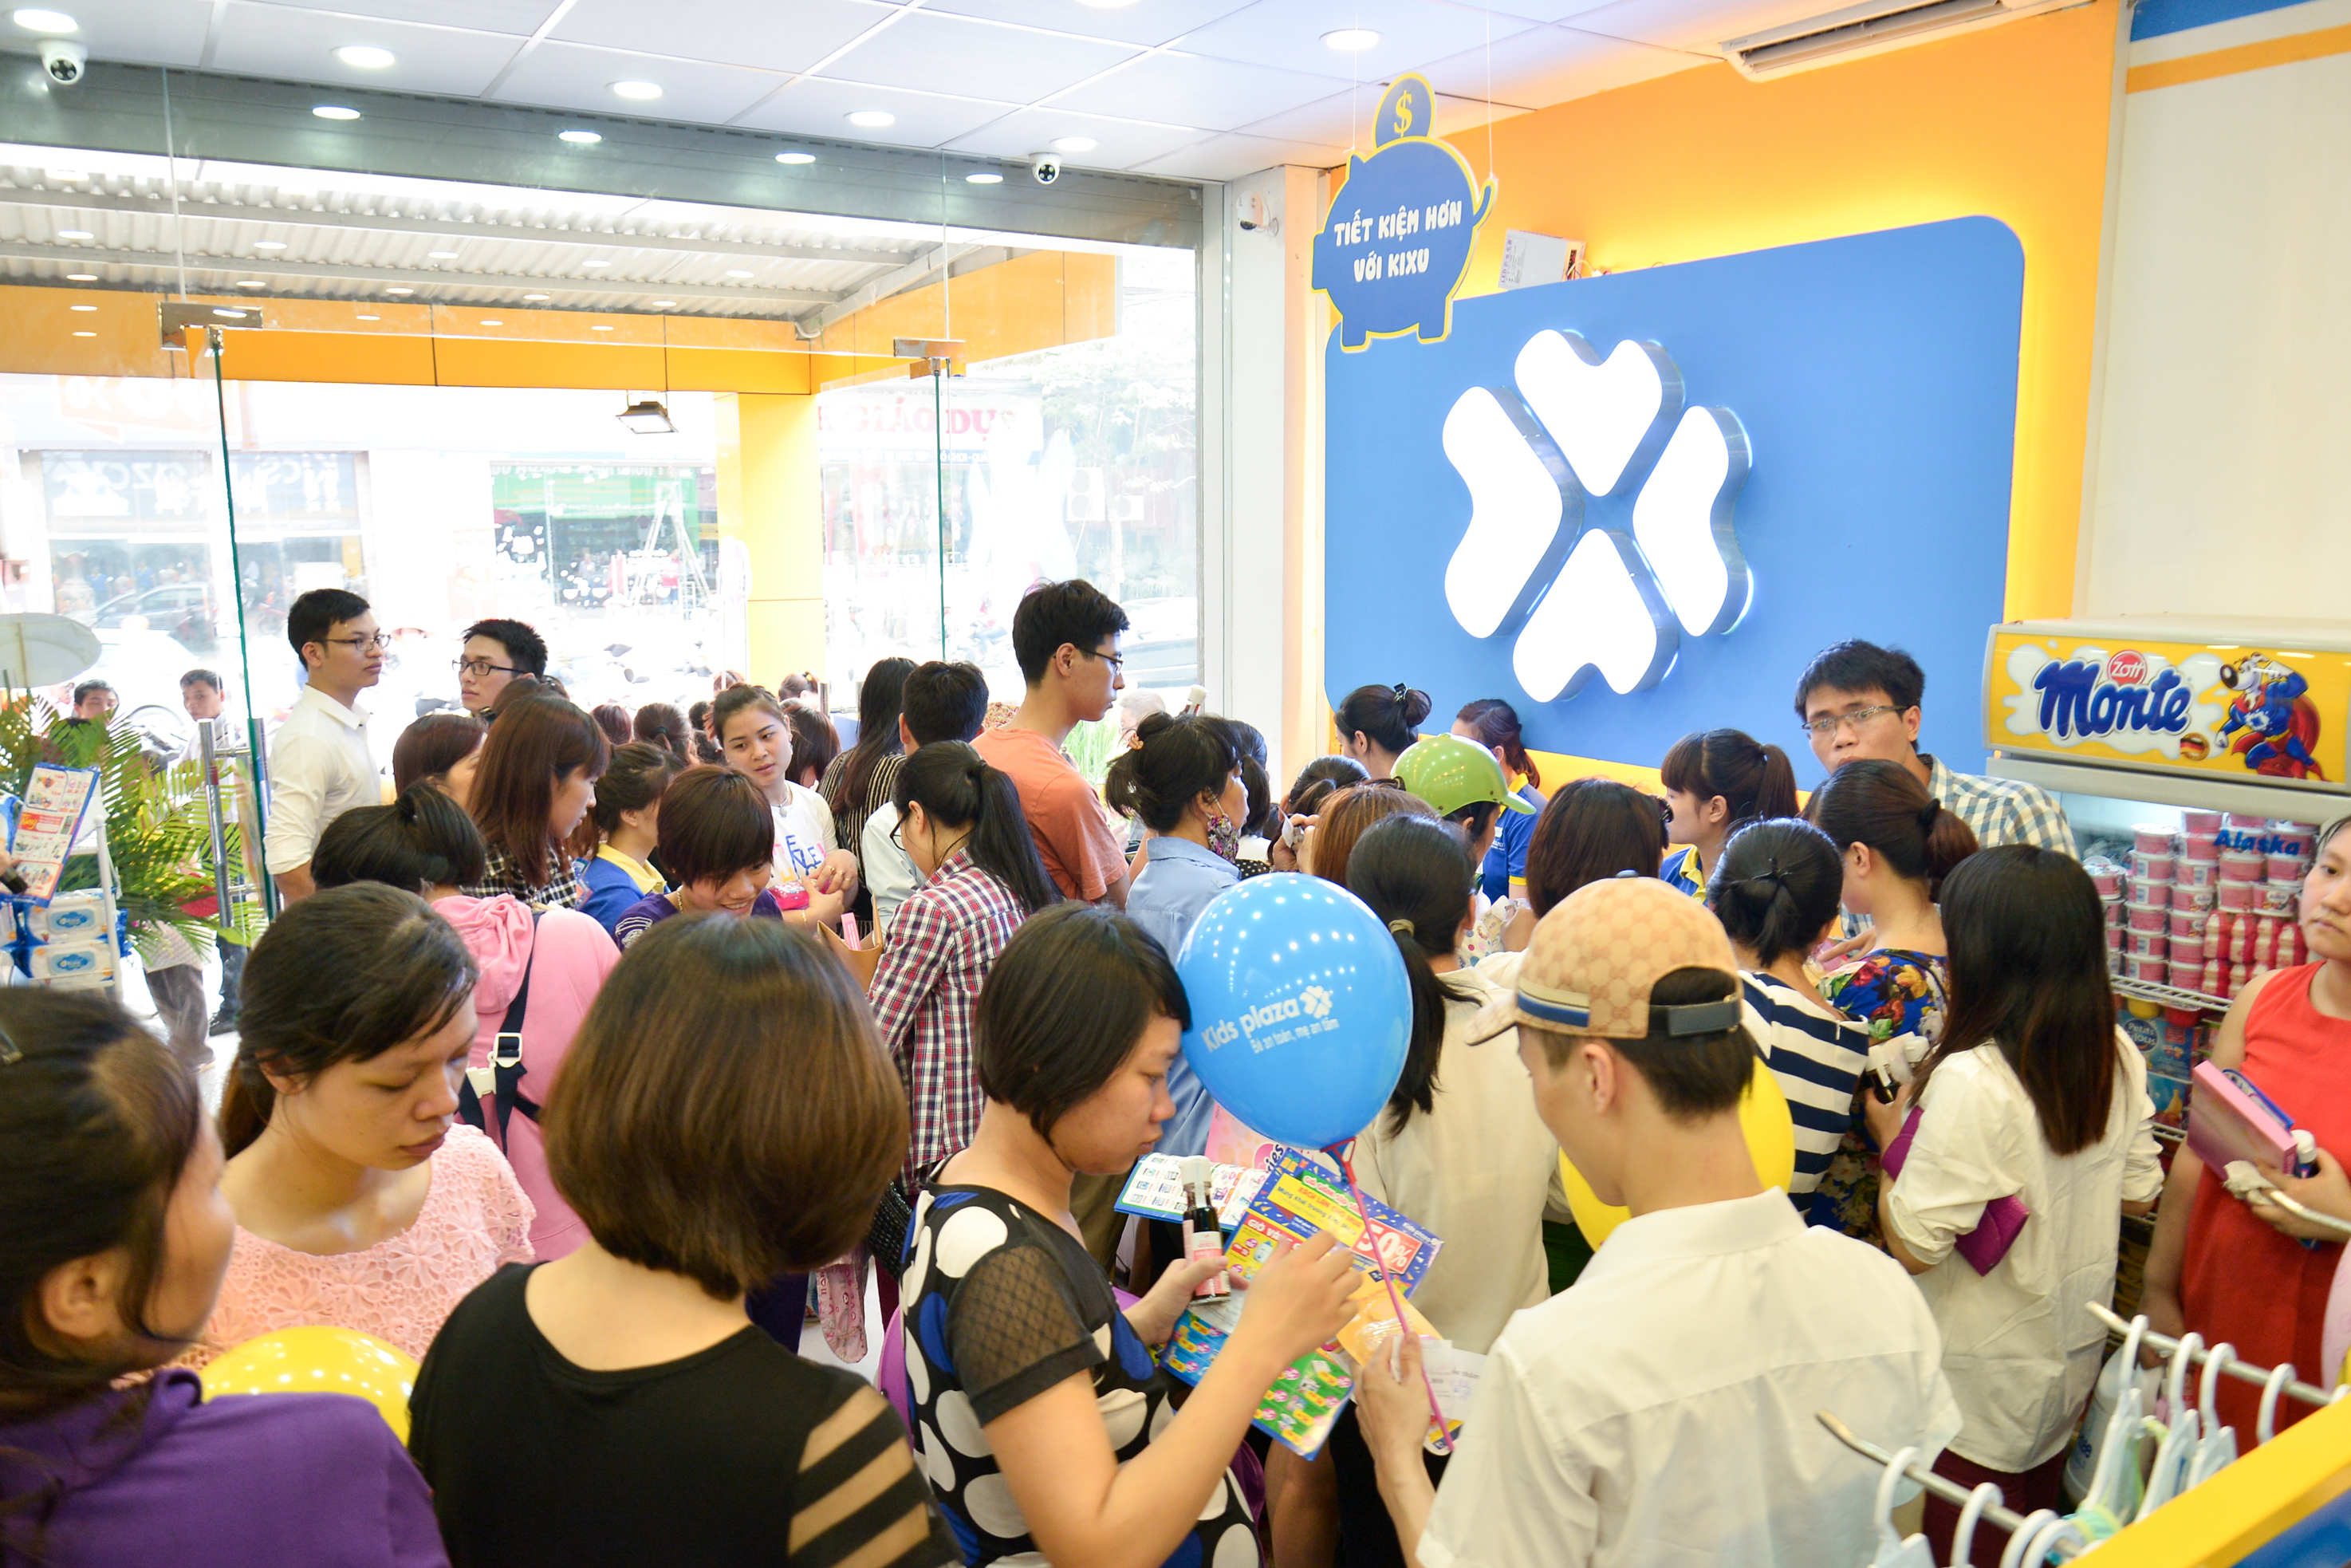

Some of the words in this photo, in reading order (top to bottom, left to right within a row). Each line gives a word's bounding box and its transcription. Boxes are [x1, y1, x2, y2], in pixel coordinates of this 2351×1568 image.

[1333, 208, 1374, 246] TIẾT
[1378, 205, 1420, 241] KIỆM
[1425, 199, 1463, 230] HƠN
[1354, 250, 1383, 282] VỚI
[1388, 247, 1430, 278] KIXU
[945, 408, 997, 443] DỤ
[2111, 661, 2145, 679] Zott
[2033, 659, 2192, 739] Monte
[2213, 829, 2302, 857] Alaska
[1201, 1019, 1239, 1053] Kids
[1239, 998, 1301, 1038] plaza
[1263, 1036, 1275, 1050] an
[1309, 1022, 1322, 1034] an
[2127, 1020, 2155, 1037] Petits
[2131, 1029, 2156, 1048] ilous
[1356, 1223, 1413, 1267] 50%
